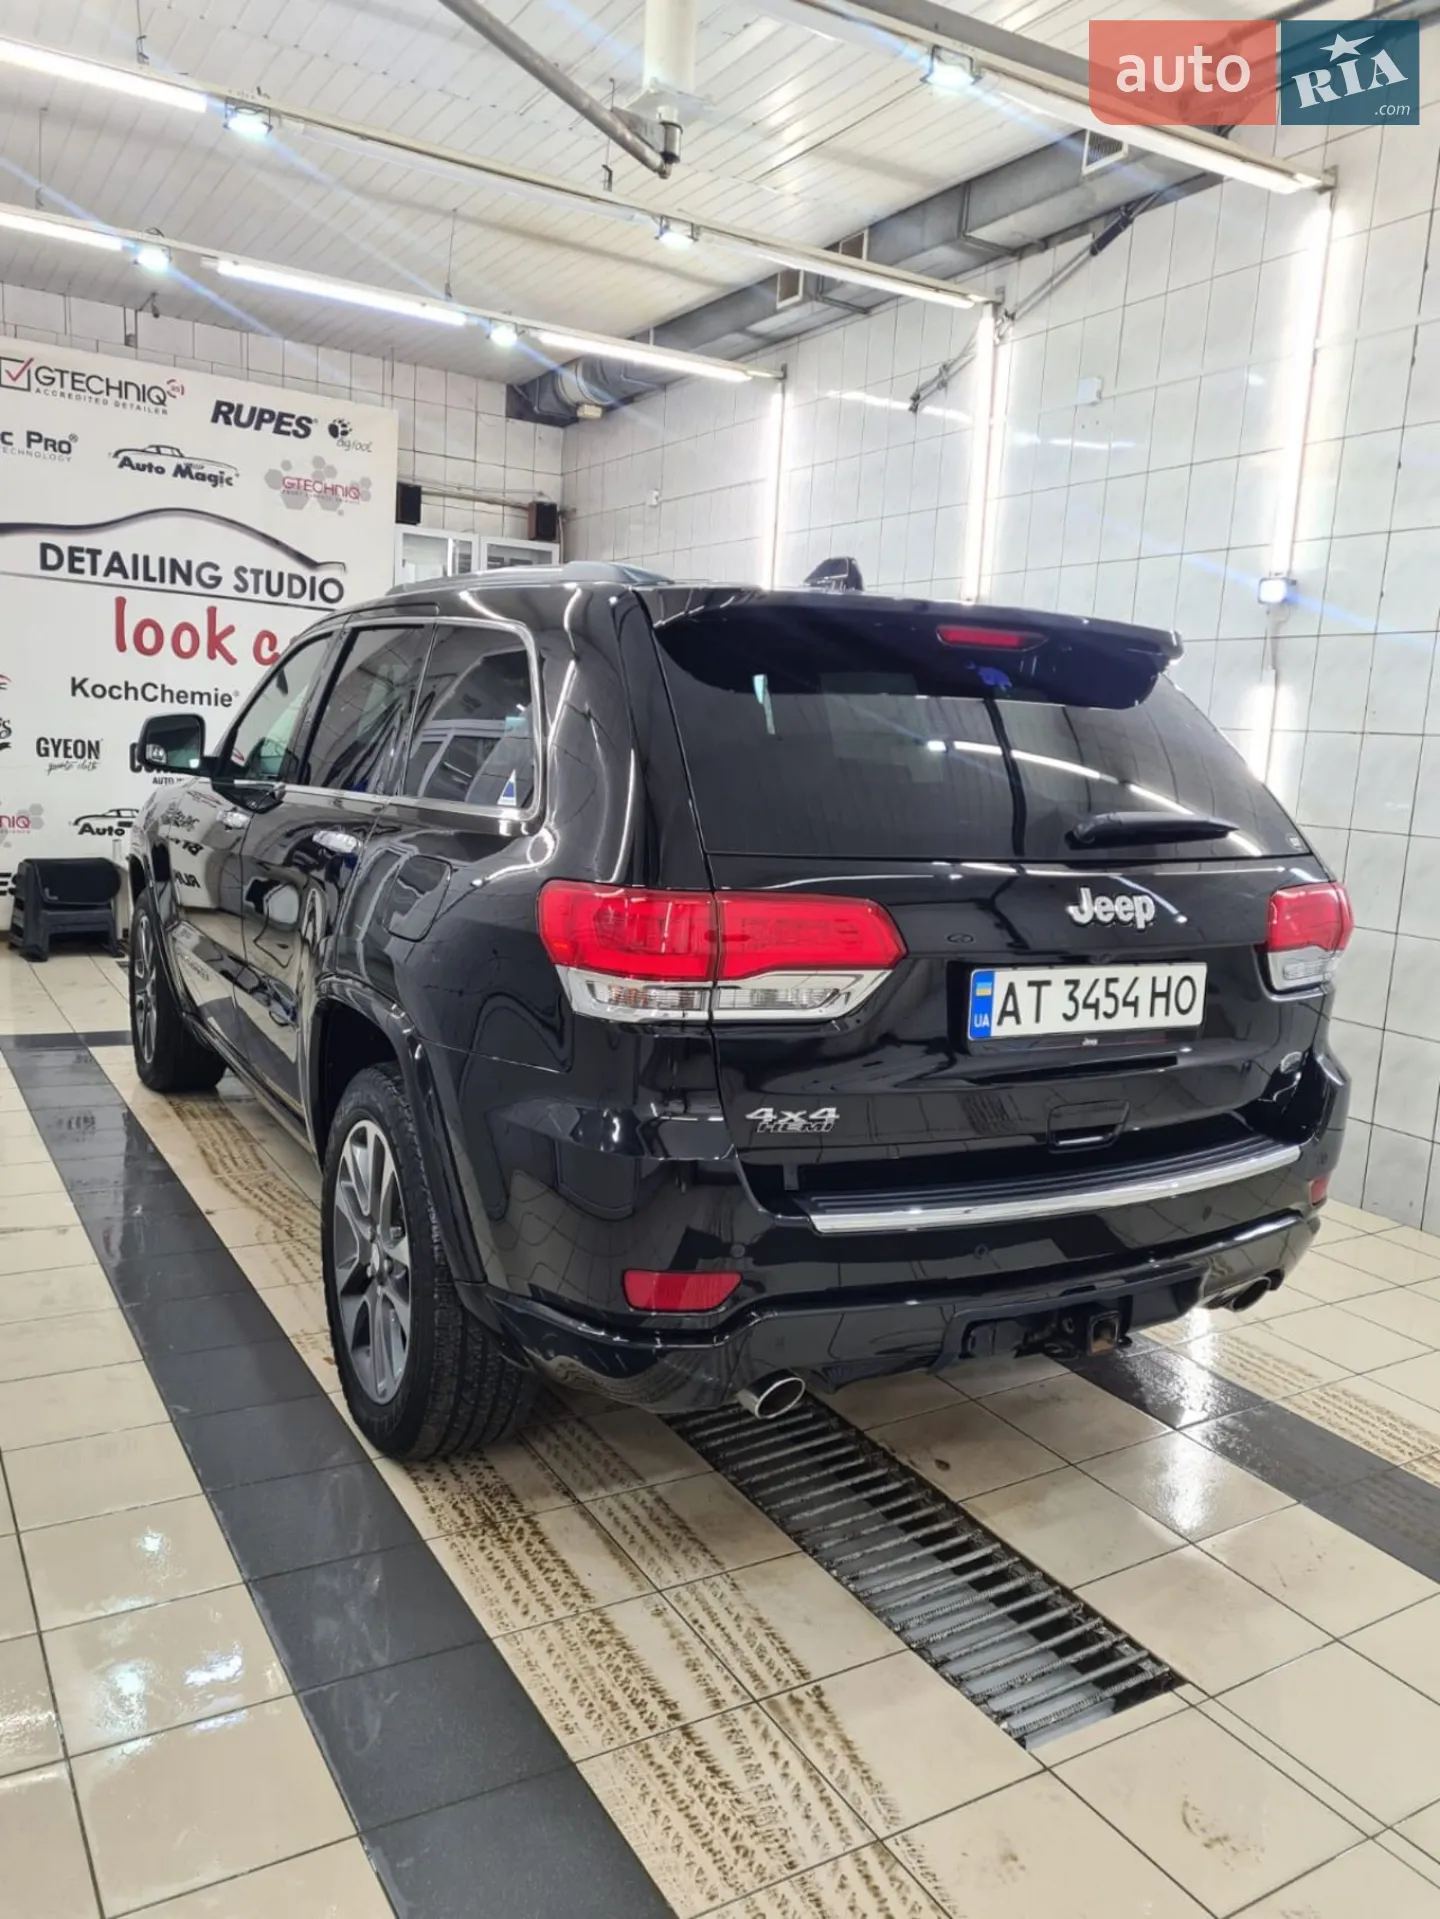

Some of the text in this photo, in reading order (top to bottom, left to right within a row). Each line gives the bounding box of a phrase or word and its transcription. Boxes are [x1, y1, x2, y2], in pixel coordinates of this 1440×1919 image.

[35, 365, 167, 407] GTECHNIQ
[35, 387, 109, 406] ACCREDITED
[210, 399, 313, 440] RUPES
[117, 456, 233, 488] Auto Magic
[282, 476, 361, 500] GTECHNIQ
[40, 542, 344, 604] DETAILING STUDIO
[115, 595, 238, 666] look
[71, 676, 233, 708] KochChemie
[36, 736, 100, 760] GYEON
[78, 822, 125, 836] Auto
[1066, 887, 1156, 929] Jeep
[996, 975, 1198, 1027] AT 3454 HO
[974, 1014, 990, 1028] UA
